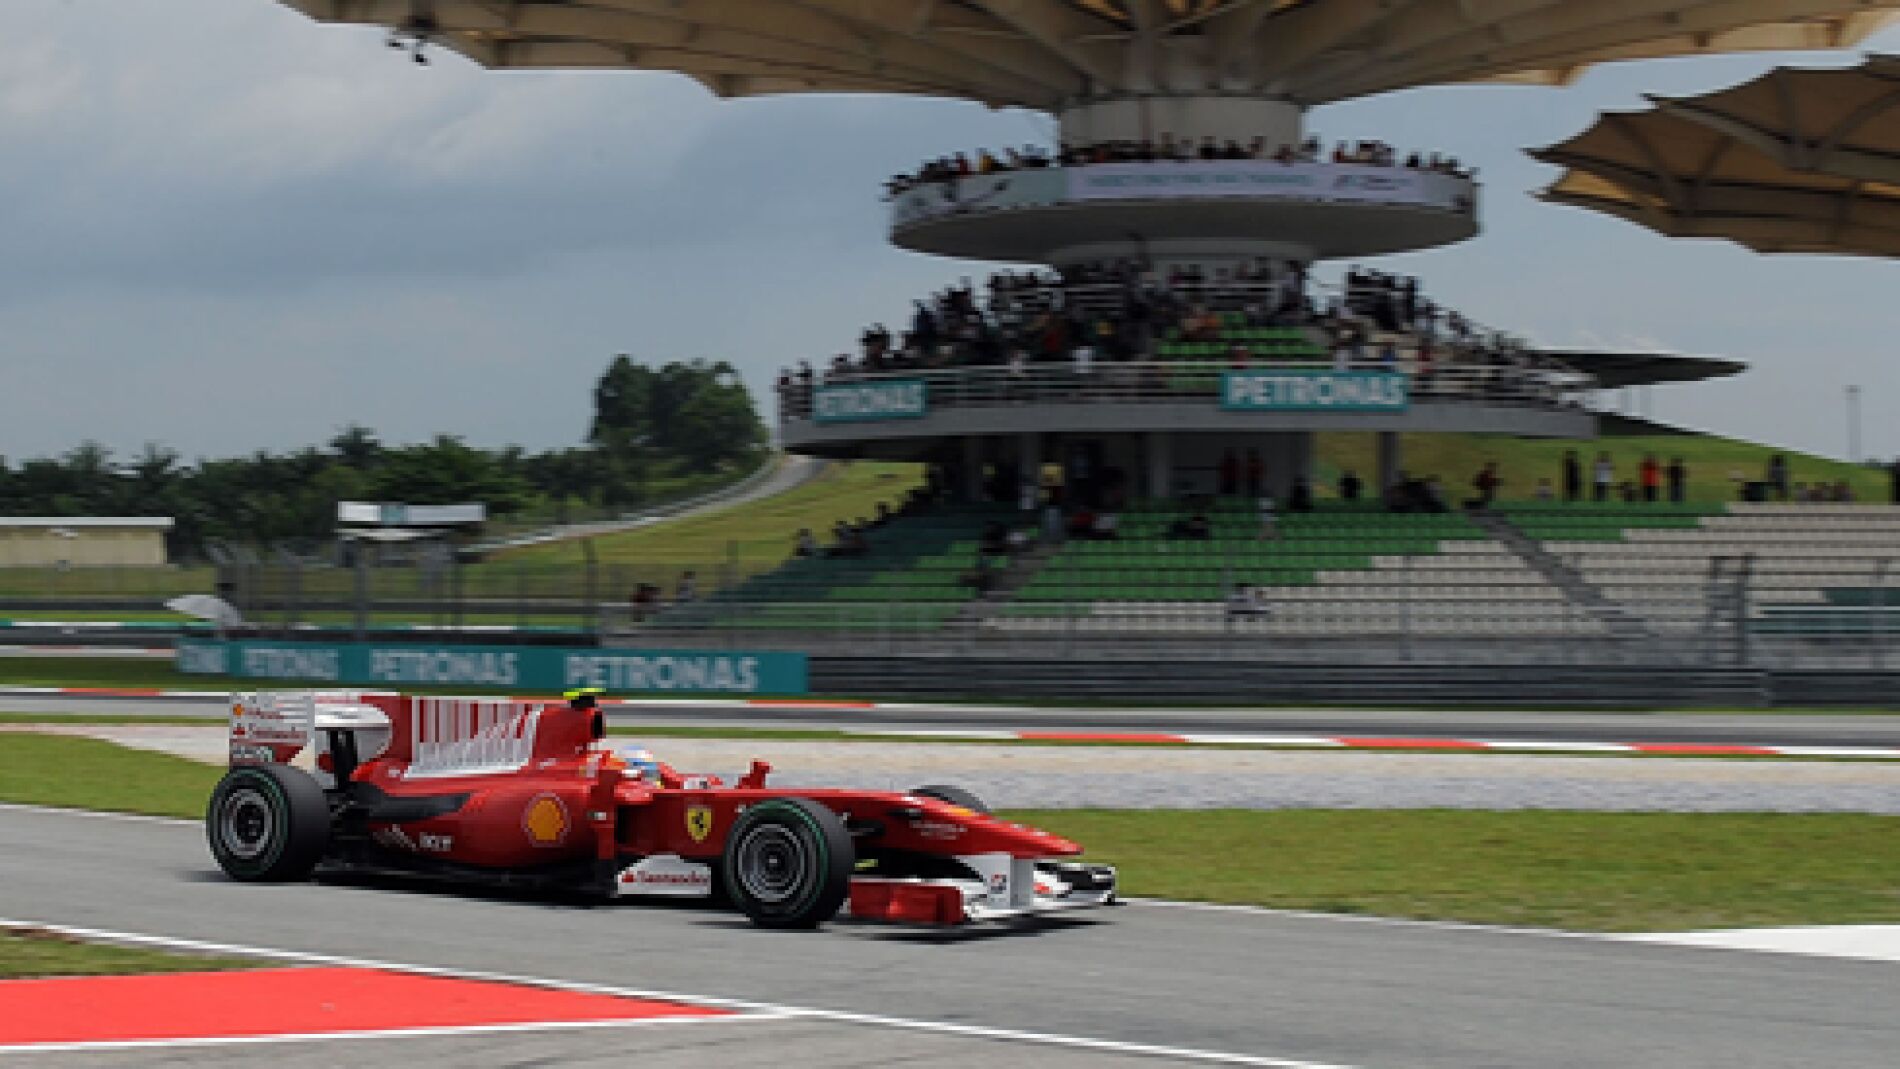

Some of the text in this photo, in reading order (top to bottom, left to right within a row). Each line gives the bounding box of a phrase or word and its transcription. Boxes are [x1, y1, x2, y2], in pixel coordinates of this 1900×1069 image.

[1228, 375, 1405, 405] PETRONAS
[370, 648, 518, 685] PETRONAS
[566, 654, 758, 691] PETRONAS
